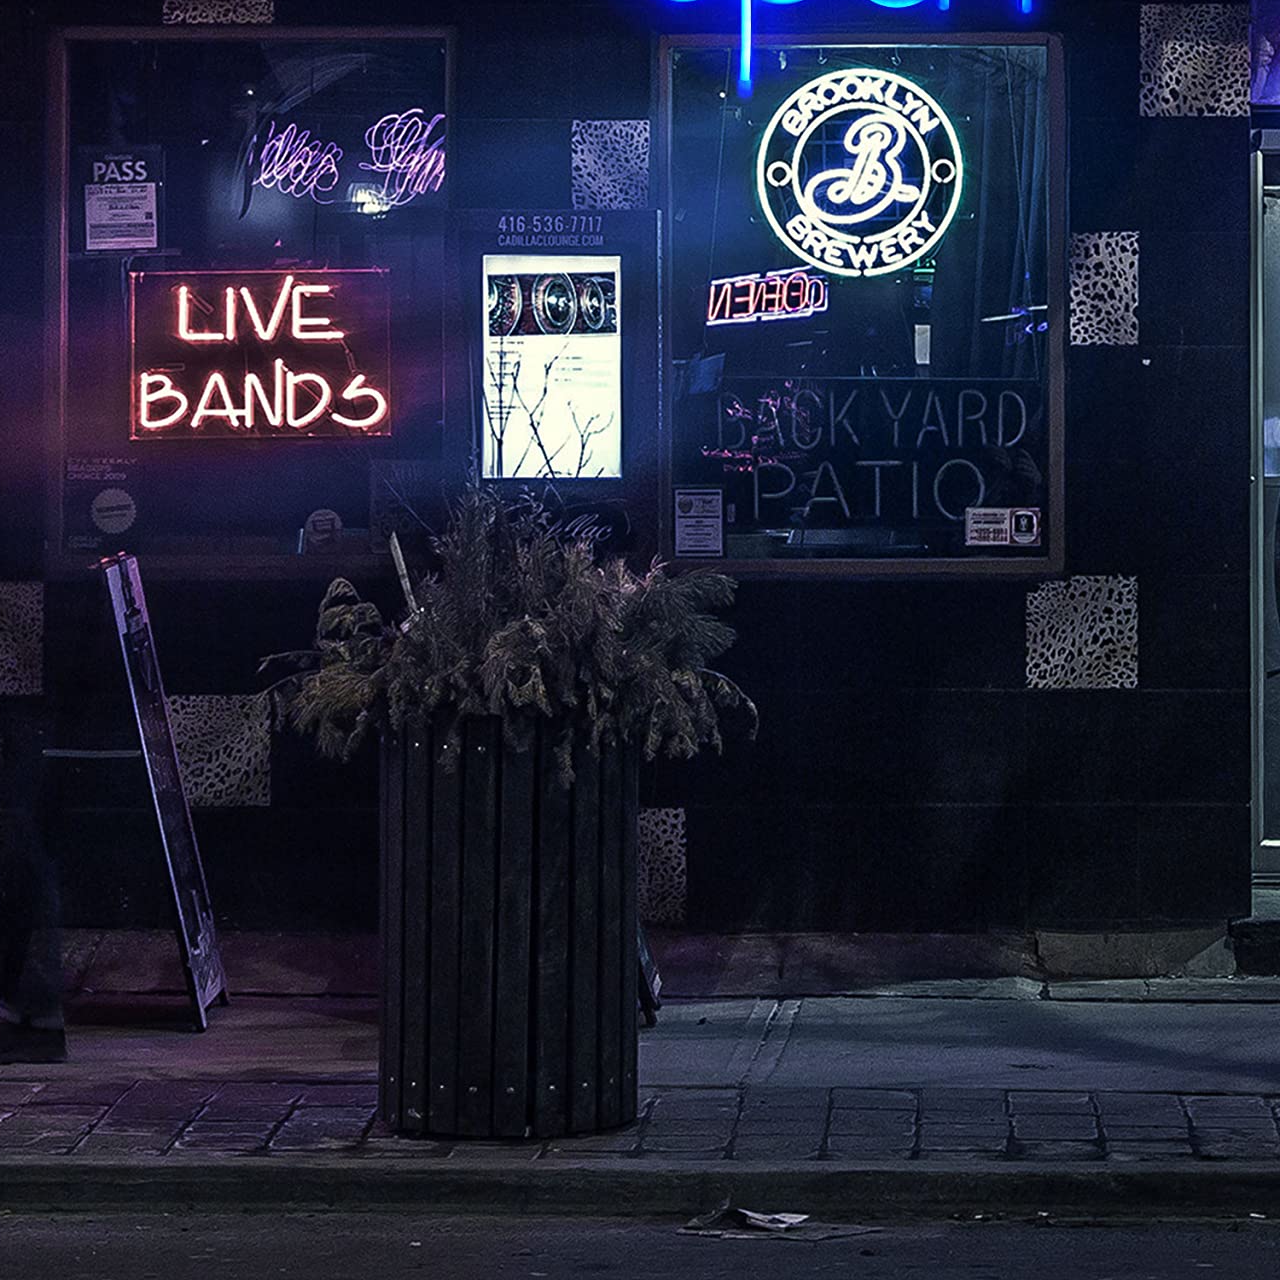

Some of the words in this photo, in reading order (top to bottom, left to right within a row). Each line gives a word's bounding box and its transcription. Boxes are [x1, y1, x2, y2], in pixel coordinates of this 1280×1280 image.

[782, 75, 940, 136] BROOKLYN
[92, 160, 148, 182] PASS
[785, 210, 936, 269] BREWERY
[178, 274, 345, 342] LIVE
[138, 357, 388, 431] BANDS
[880, 388, 1027, 449] YARD
[753, 457, 986, 521] PATIO
